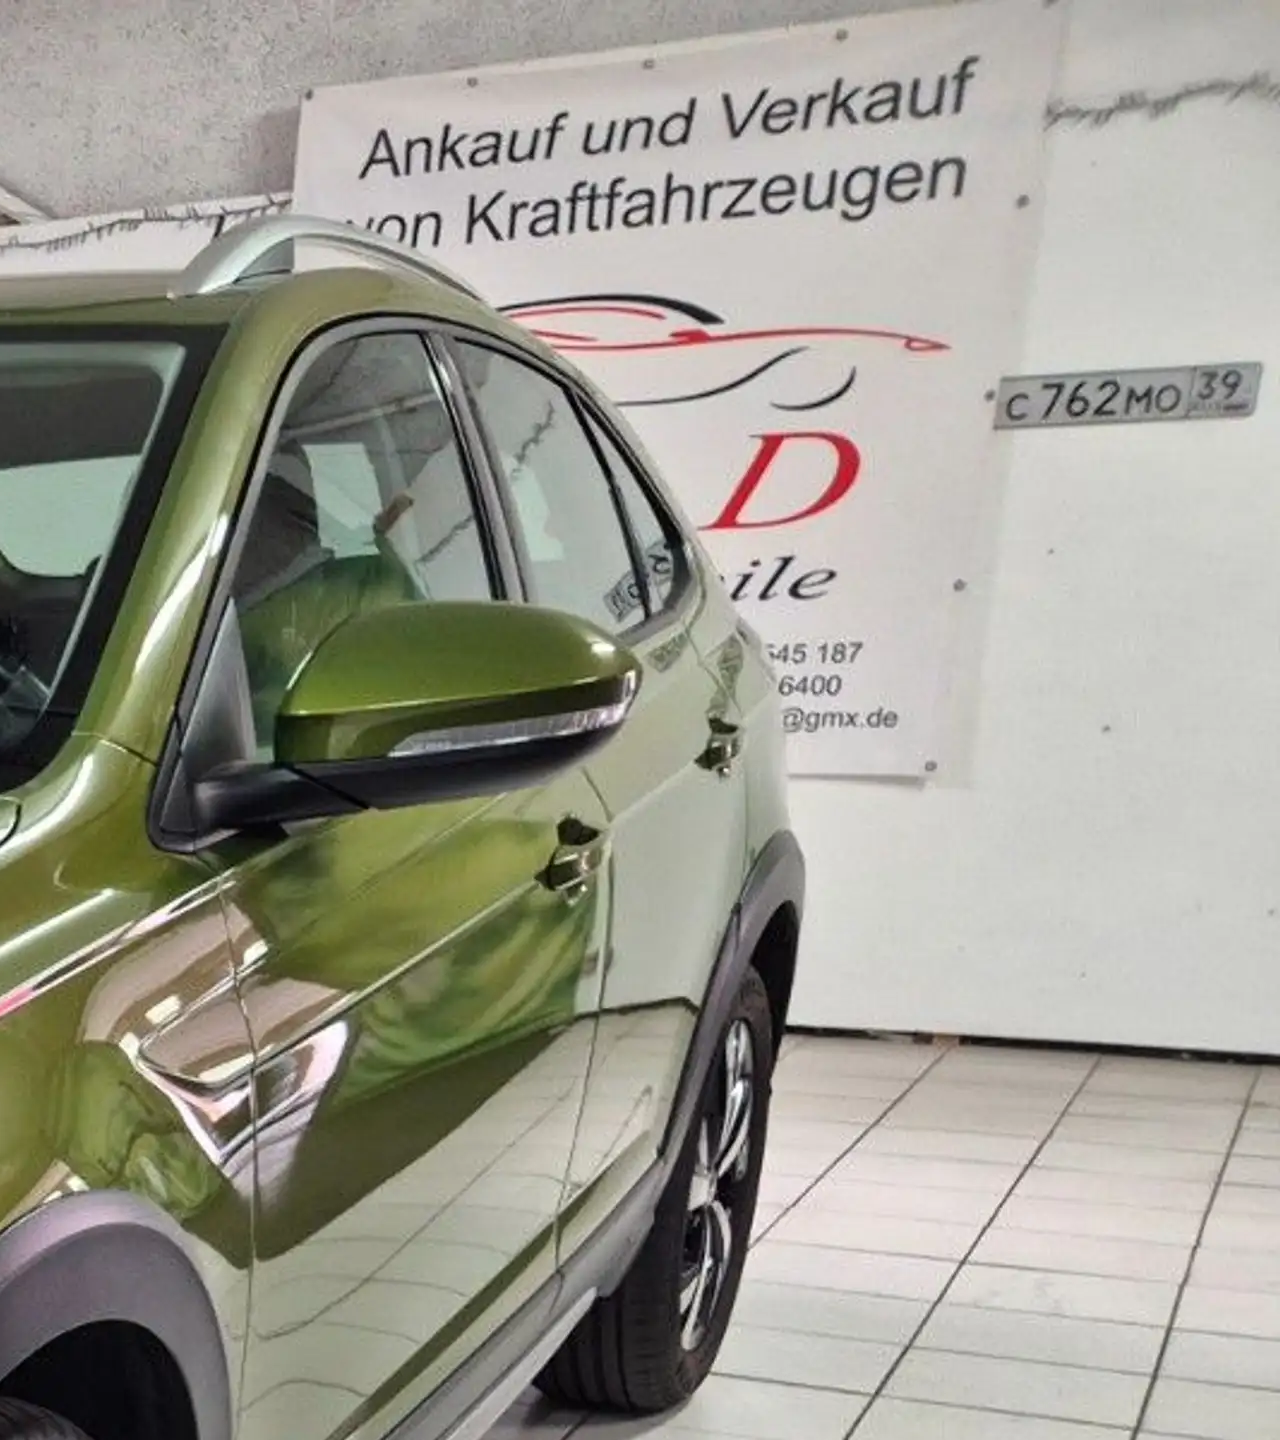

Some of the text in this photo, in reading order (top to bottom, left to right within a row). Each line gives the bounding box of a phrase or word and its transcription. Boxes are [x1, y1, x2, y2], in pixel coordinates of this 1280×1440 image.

[358, 55, 980, 180] Ankauf und Verkauf
[465, 154, 968, 244] Kraftfahrzeugen
[1197, 369, 1245, 400] 39
[696, 431, 862, 531] D
[719, 554, 837, 602] ile
[817, 641, 864, 664] 187
[778, 674, 843, 696] 6400
